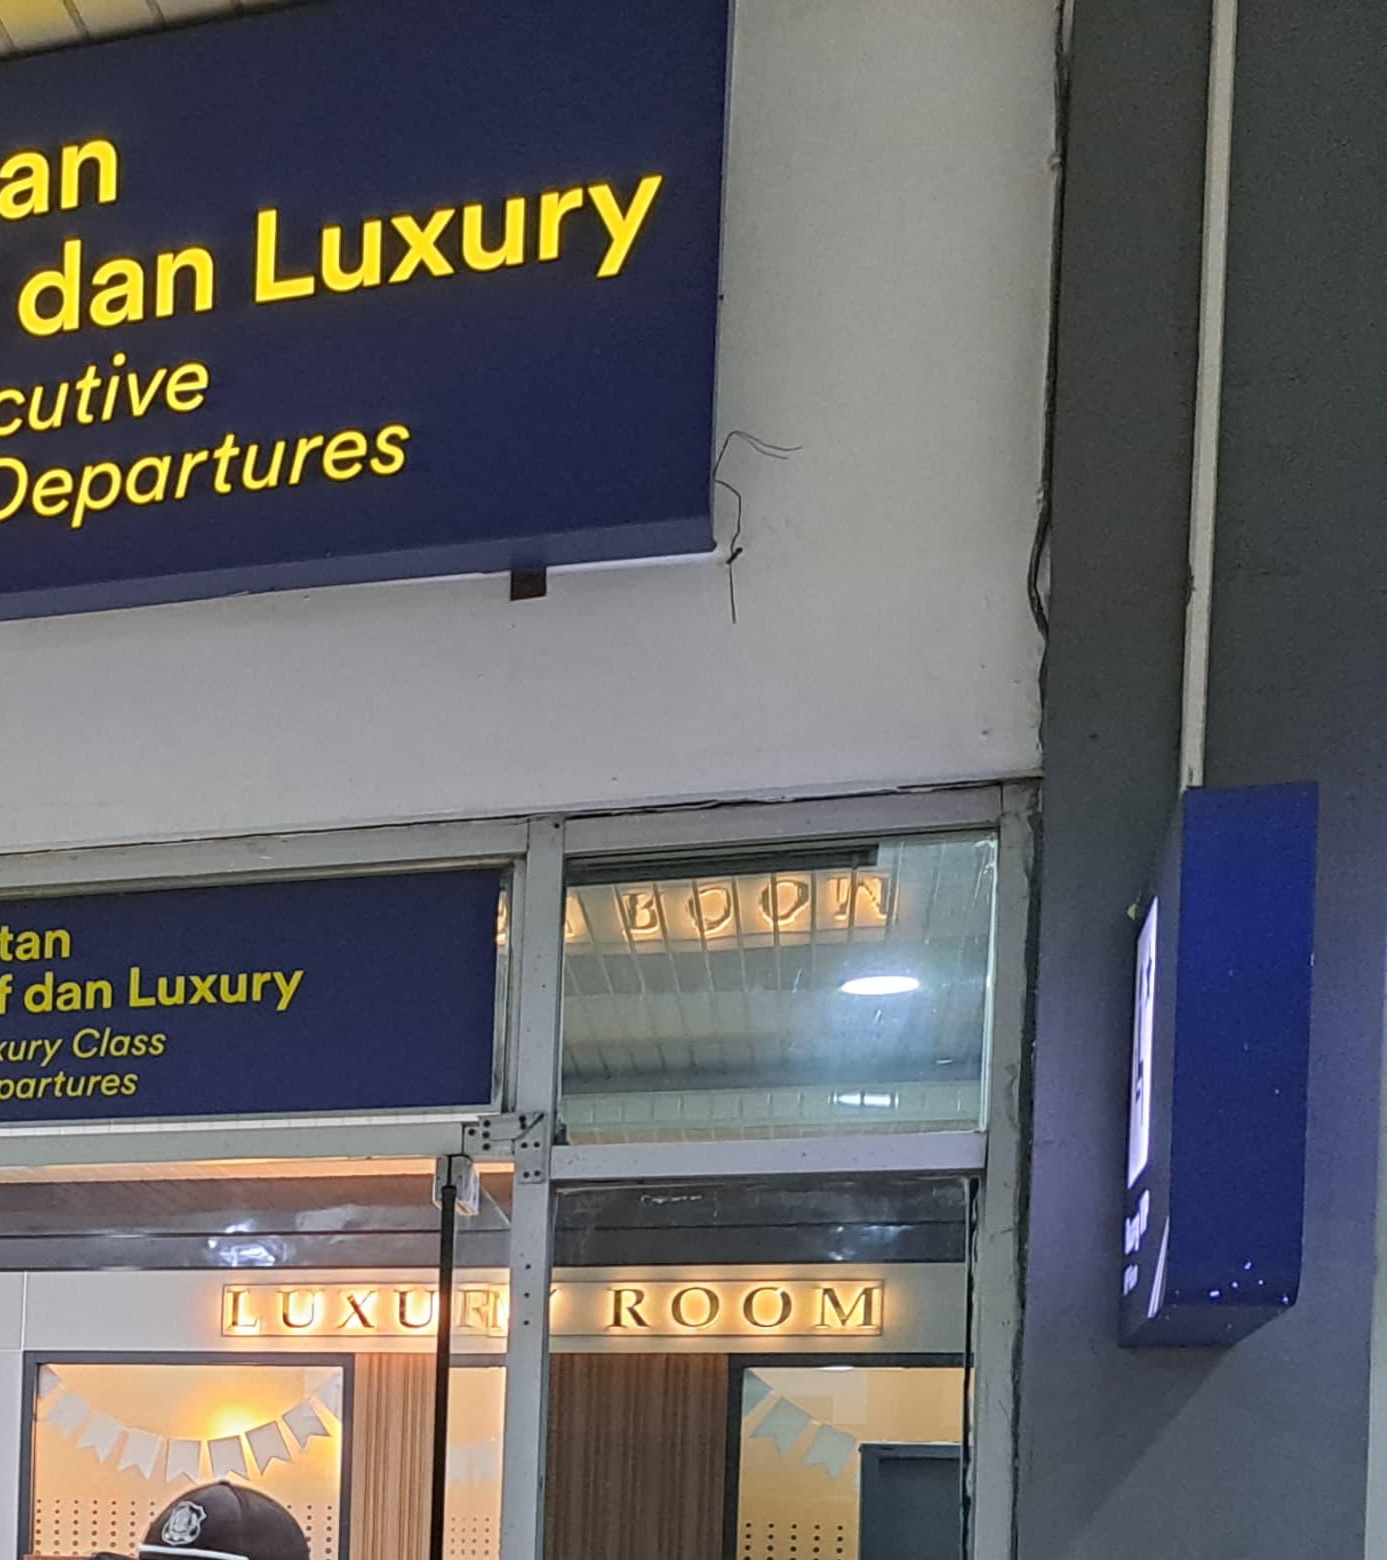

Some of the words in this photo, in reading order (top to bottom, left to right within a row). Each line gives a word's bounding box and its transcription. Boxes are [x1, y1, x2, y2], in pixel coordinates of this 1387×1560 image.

[17, 239, 214, 337] dan
[255, 174, 663, 303] Luxury
[23, 972, 112, 1013] dan
[129, 967, 304, 1011] Luxury
[73, 1028, 165, 1058] Class
[607, 1285, 880, 1330] ROOM
